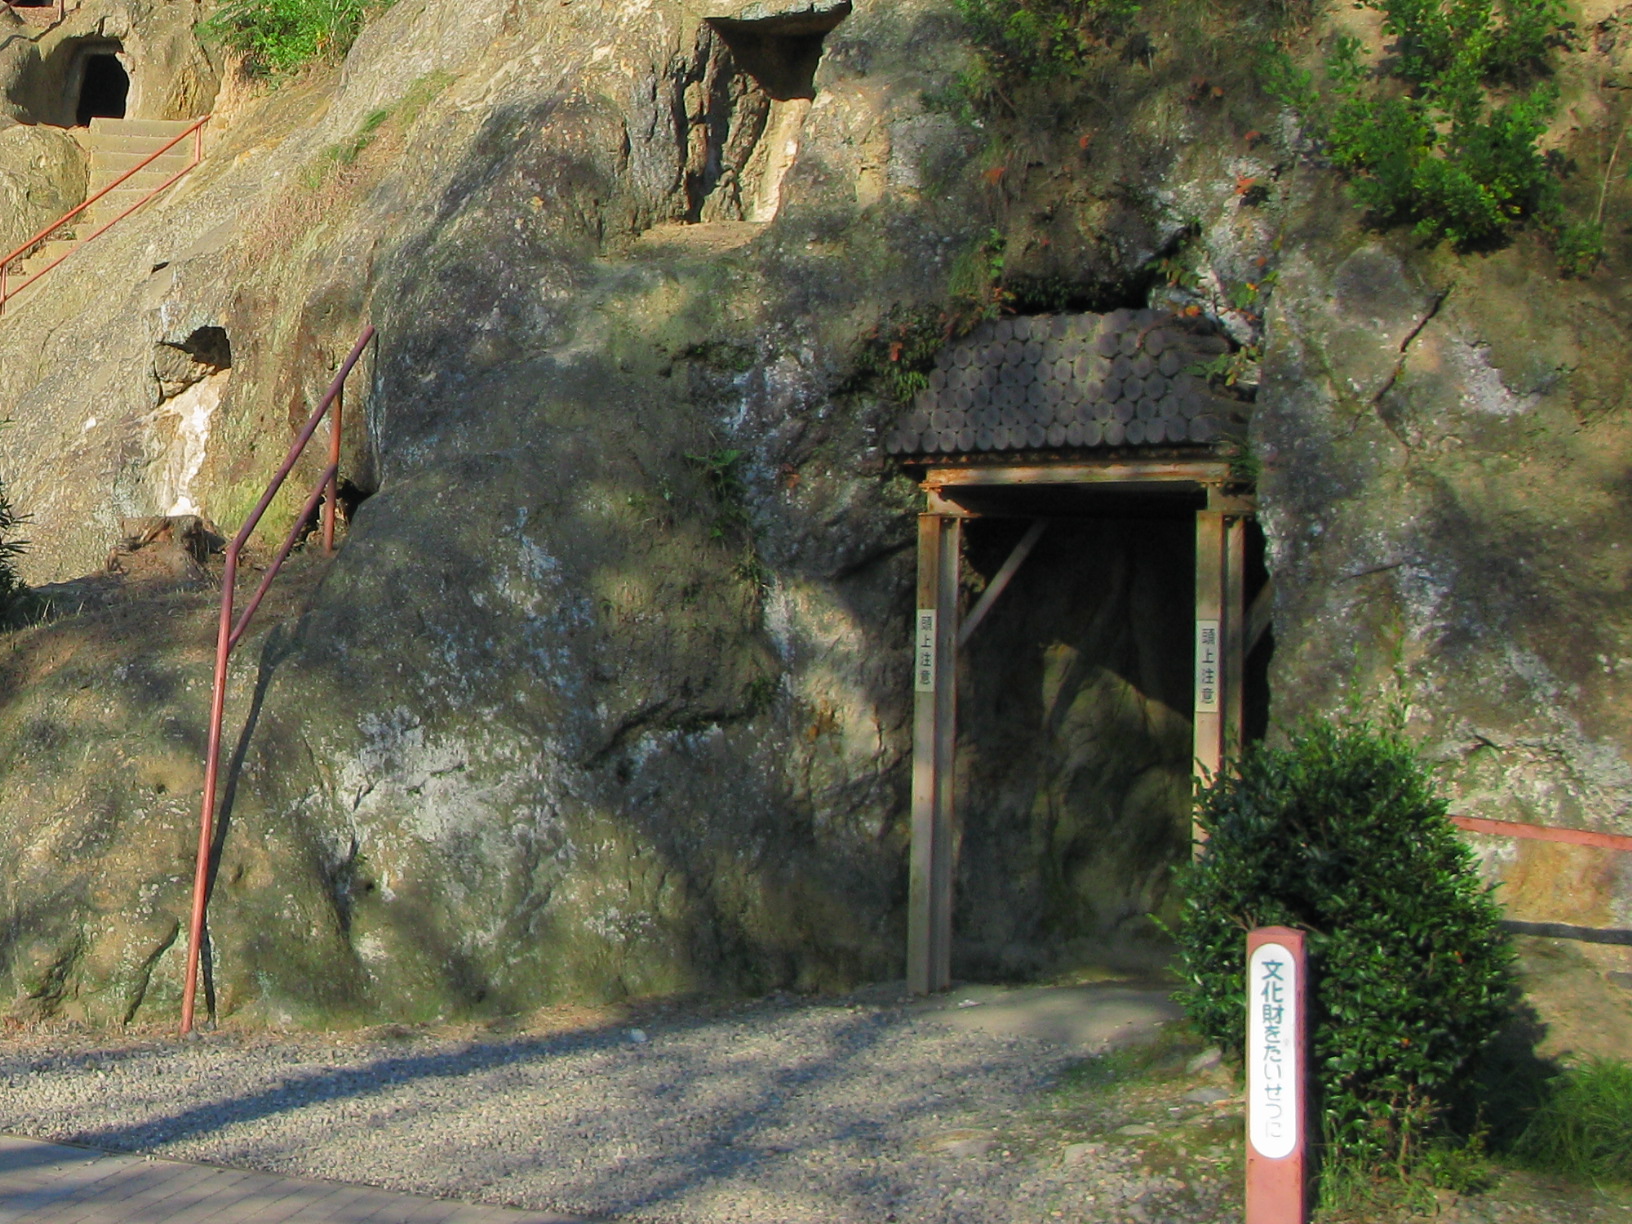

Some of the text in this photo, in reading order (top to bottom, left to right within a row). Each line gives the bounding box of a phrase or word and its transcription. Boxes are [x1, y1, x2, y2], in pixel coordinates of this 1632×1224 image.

[920, 616, 932, 685] 頭上注意
[1201, 628, 1215, 705] 頭上注意
[1260, 959, 1285, 1139] 文化財をたいせつに
